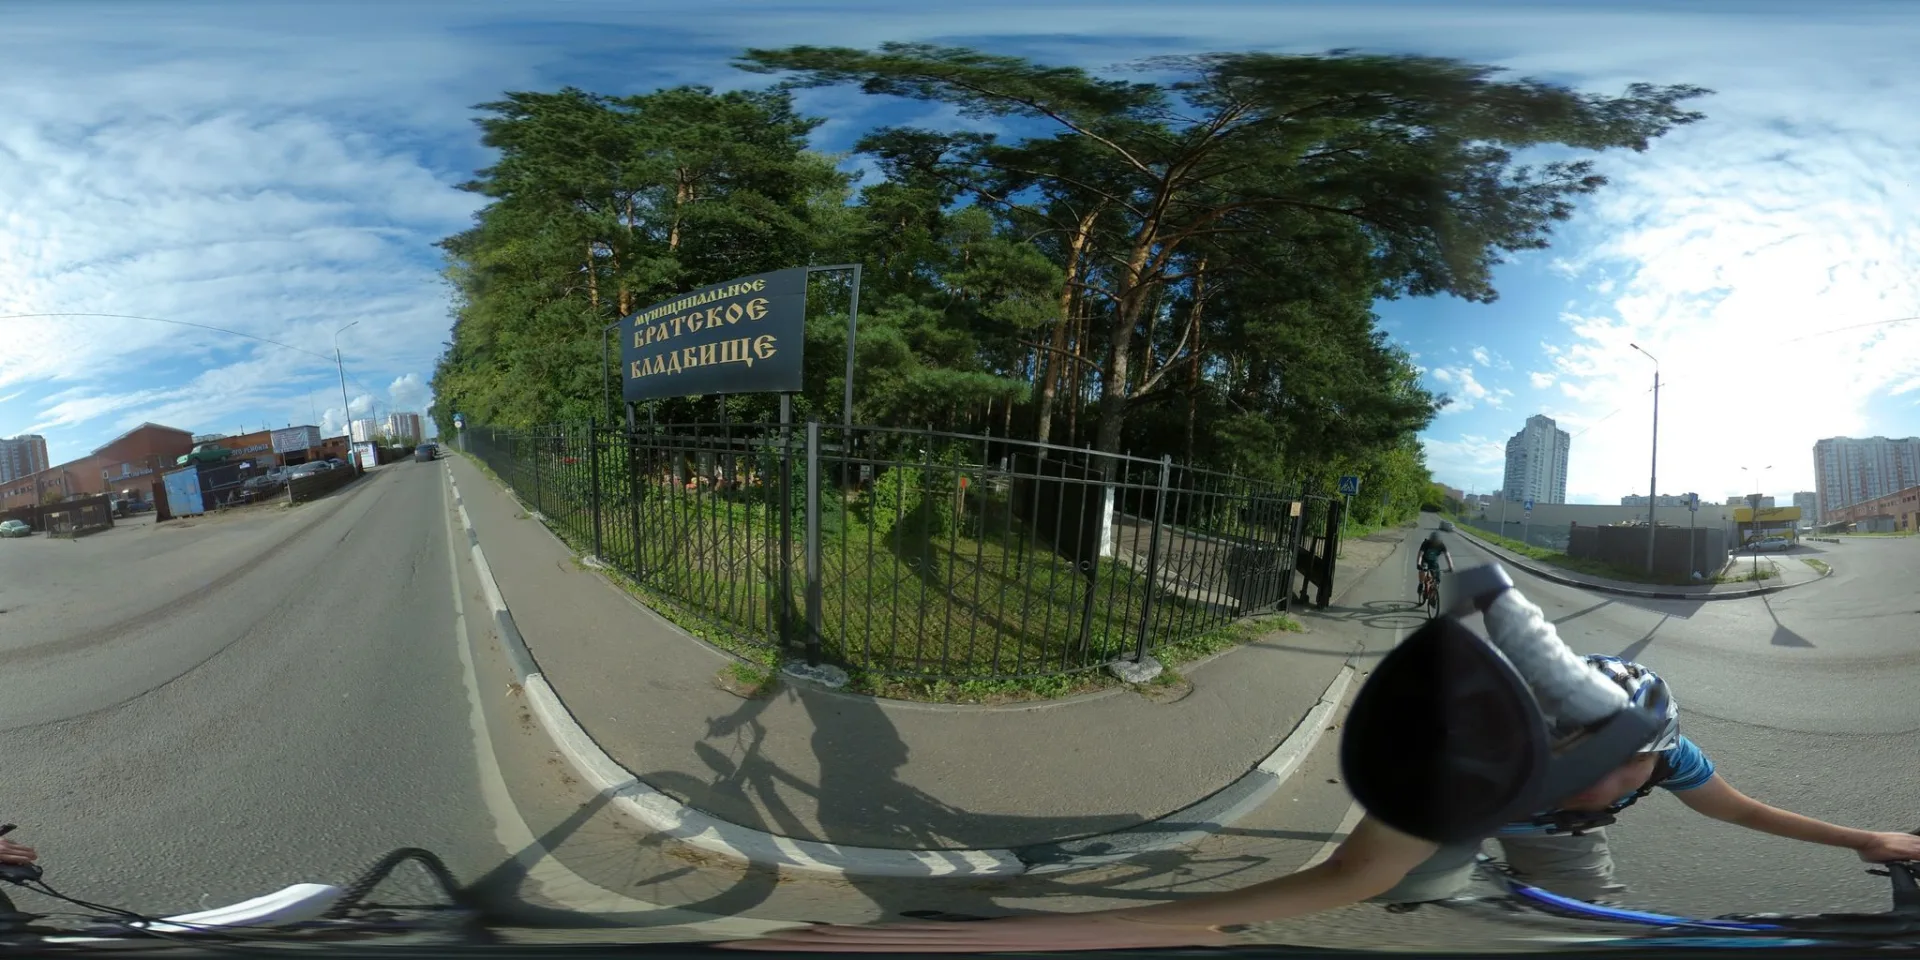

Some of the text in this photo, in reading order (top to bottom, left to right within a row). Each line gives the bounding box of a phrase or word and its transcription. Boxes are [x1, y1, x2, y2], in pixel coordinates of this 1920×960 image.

[634, 279, 766, 326] МУНИЦИПАЛЬНОЕ
[634, 298, 769, 348] БРАТСКОЕ
[631, 335, 777, 379] КЛАДБИЩЕ
